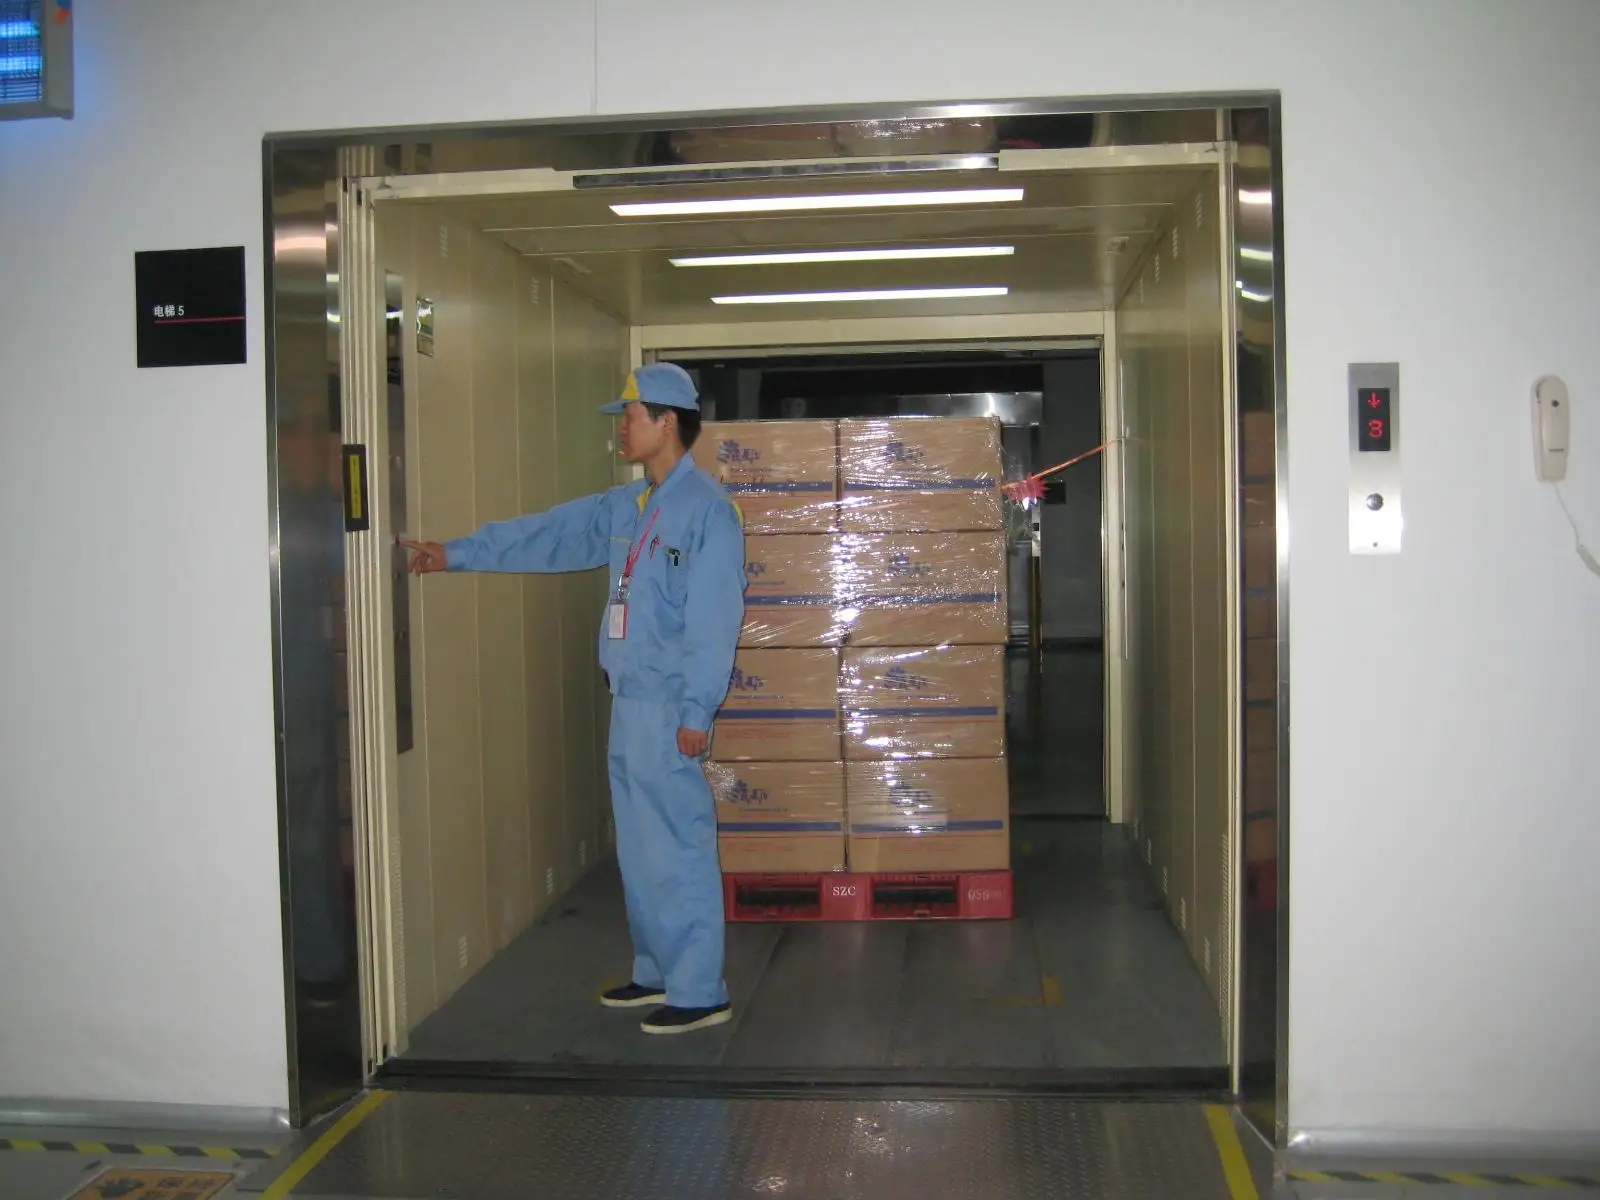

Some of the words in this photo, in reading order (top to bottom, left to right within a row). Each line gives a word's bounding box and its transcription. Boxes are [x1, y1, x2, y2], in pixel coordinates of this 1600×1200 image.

[154, 305, 176, 317] 电梯
[178, 305, 185, 316] 5
[1368, 419, 1384, 439] 3
[832, 886, 857, 896] SZC
